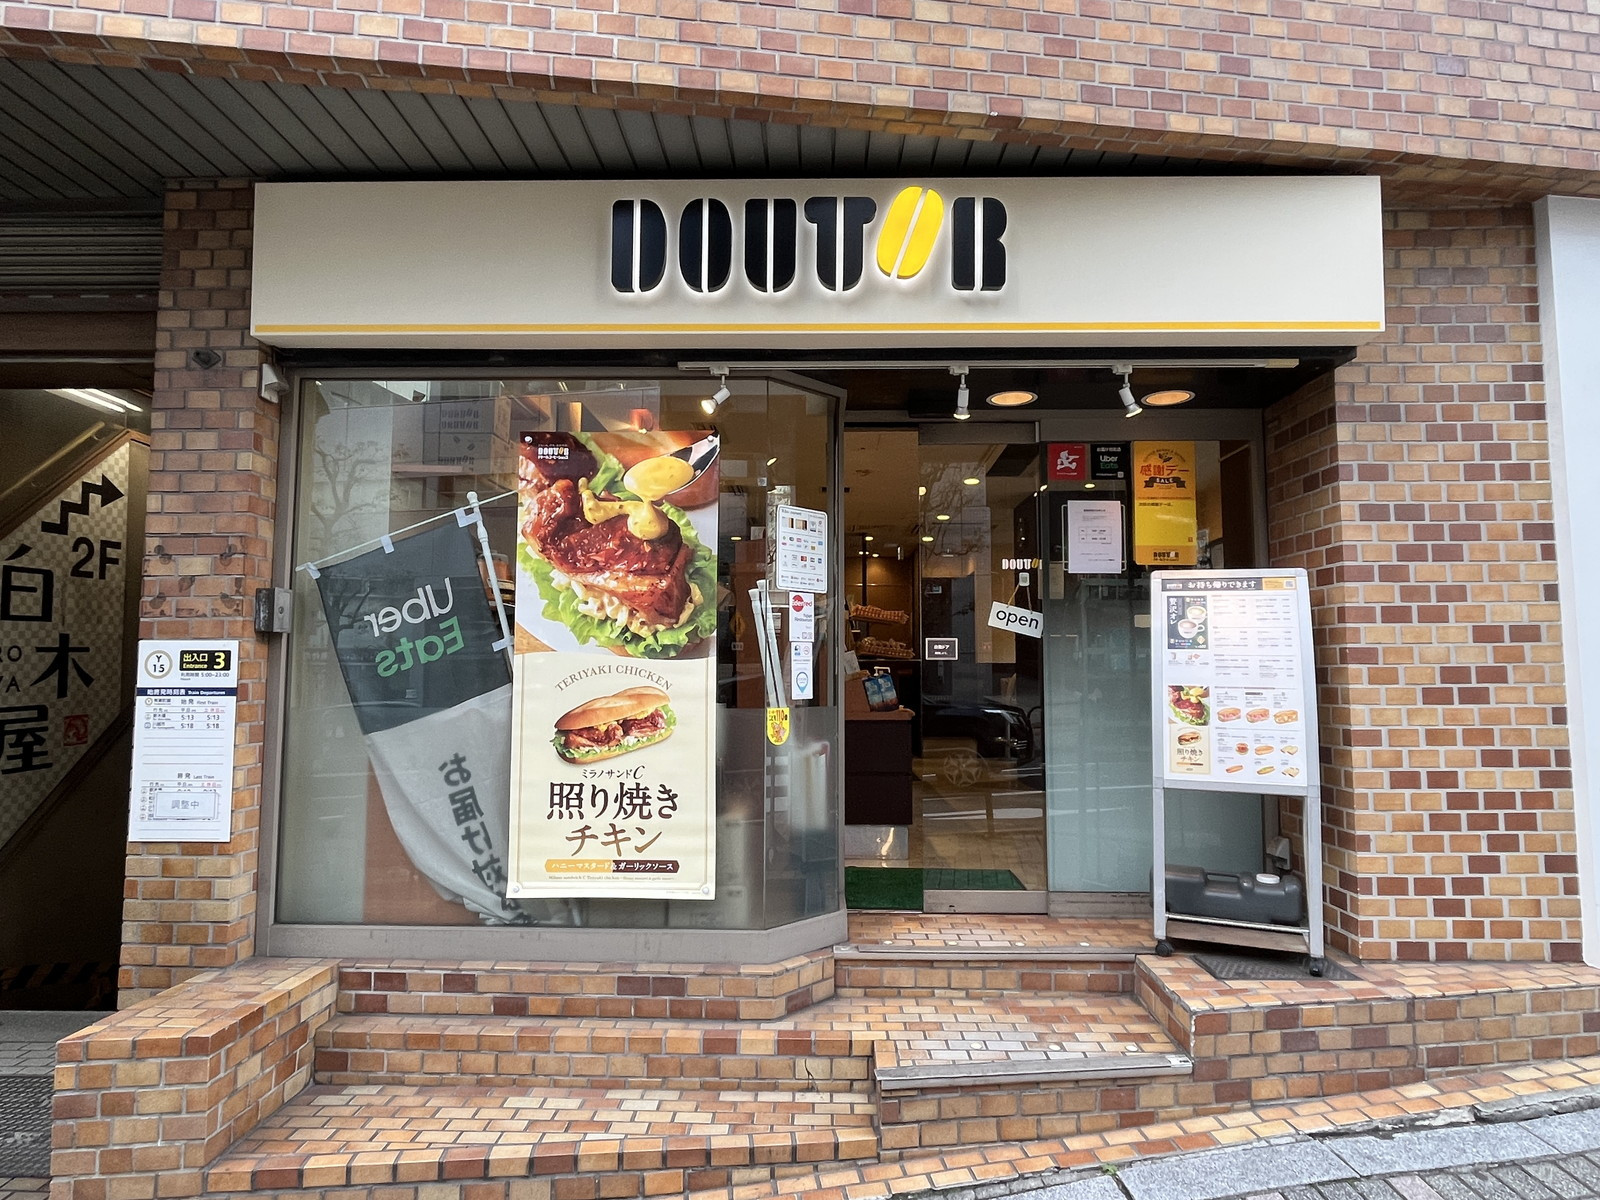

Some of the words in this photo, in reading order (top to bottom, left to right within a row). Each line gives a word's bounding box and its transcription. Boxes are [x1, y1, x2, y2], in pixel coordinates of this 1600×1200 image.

[611, 186, 1008, 293] DOUTOR
[1140, 464, 1190, 476] 感謝デー
[70, 537, 122, 580] 2F
[1188, 580, 1257, 588] お持ち帰りできます
[996, 610, 1039, 629] open
[183, 653, 208, 662] 出入口
[213, 652, 226, 669] 3
[153, 664, 165, 673] 15
[555, 665, 612, 692] TERIYAKI
[616, 665, 673, 691] CHICKEN
[582, 765, 646, 779] ミラノサンドC
[547, 782, 679, 820] 照り焼き
[565, 823, 662, 857] チキン
